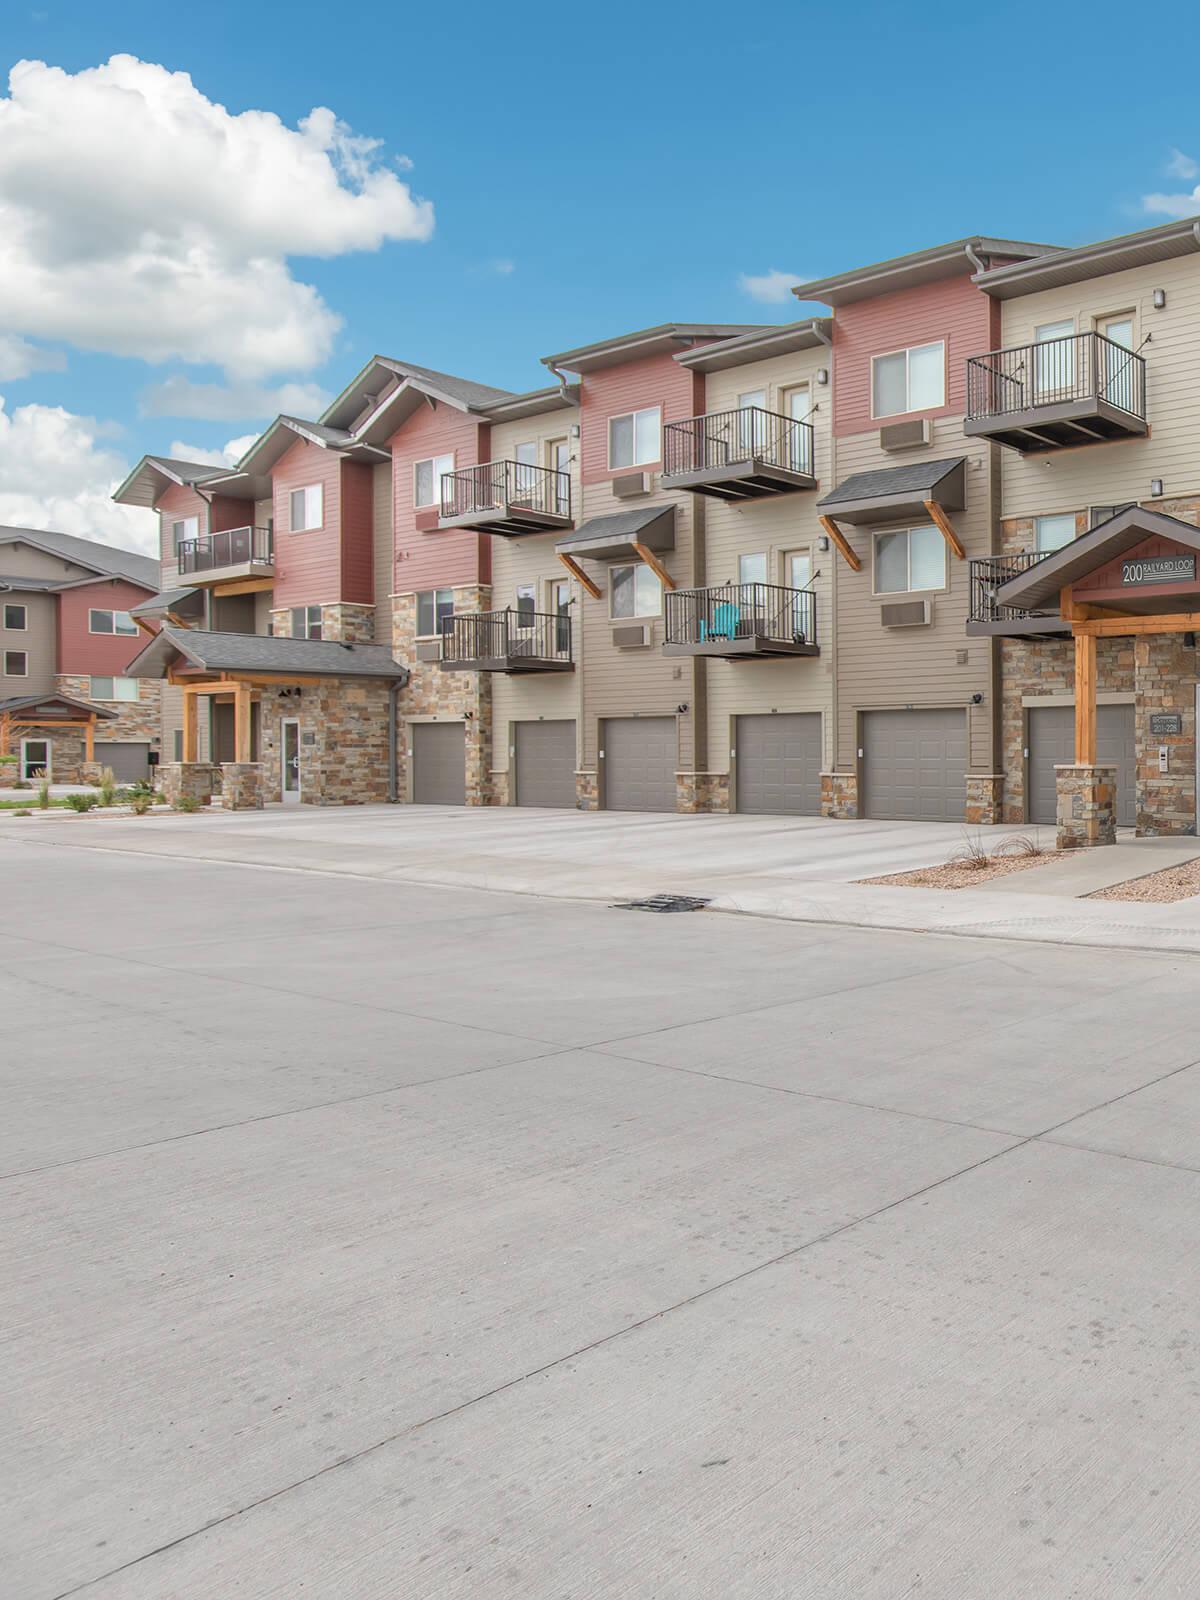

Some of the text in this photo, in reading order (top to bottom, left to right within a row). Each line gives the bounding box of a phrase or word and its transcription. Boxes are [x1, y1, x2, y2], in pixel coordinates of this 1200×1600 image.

[1123, 559, 1193, 581] 200 RAILYARD LOOP
